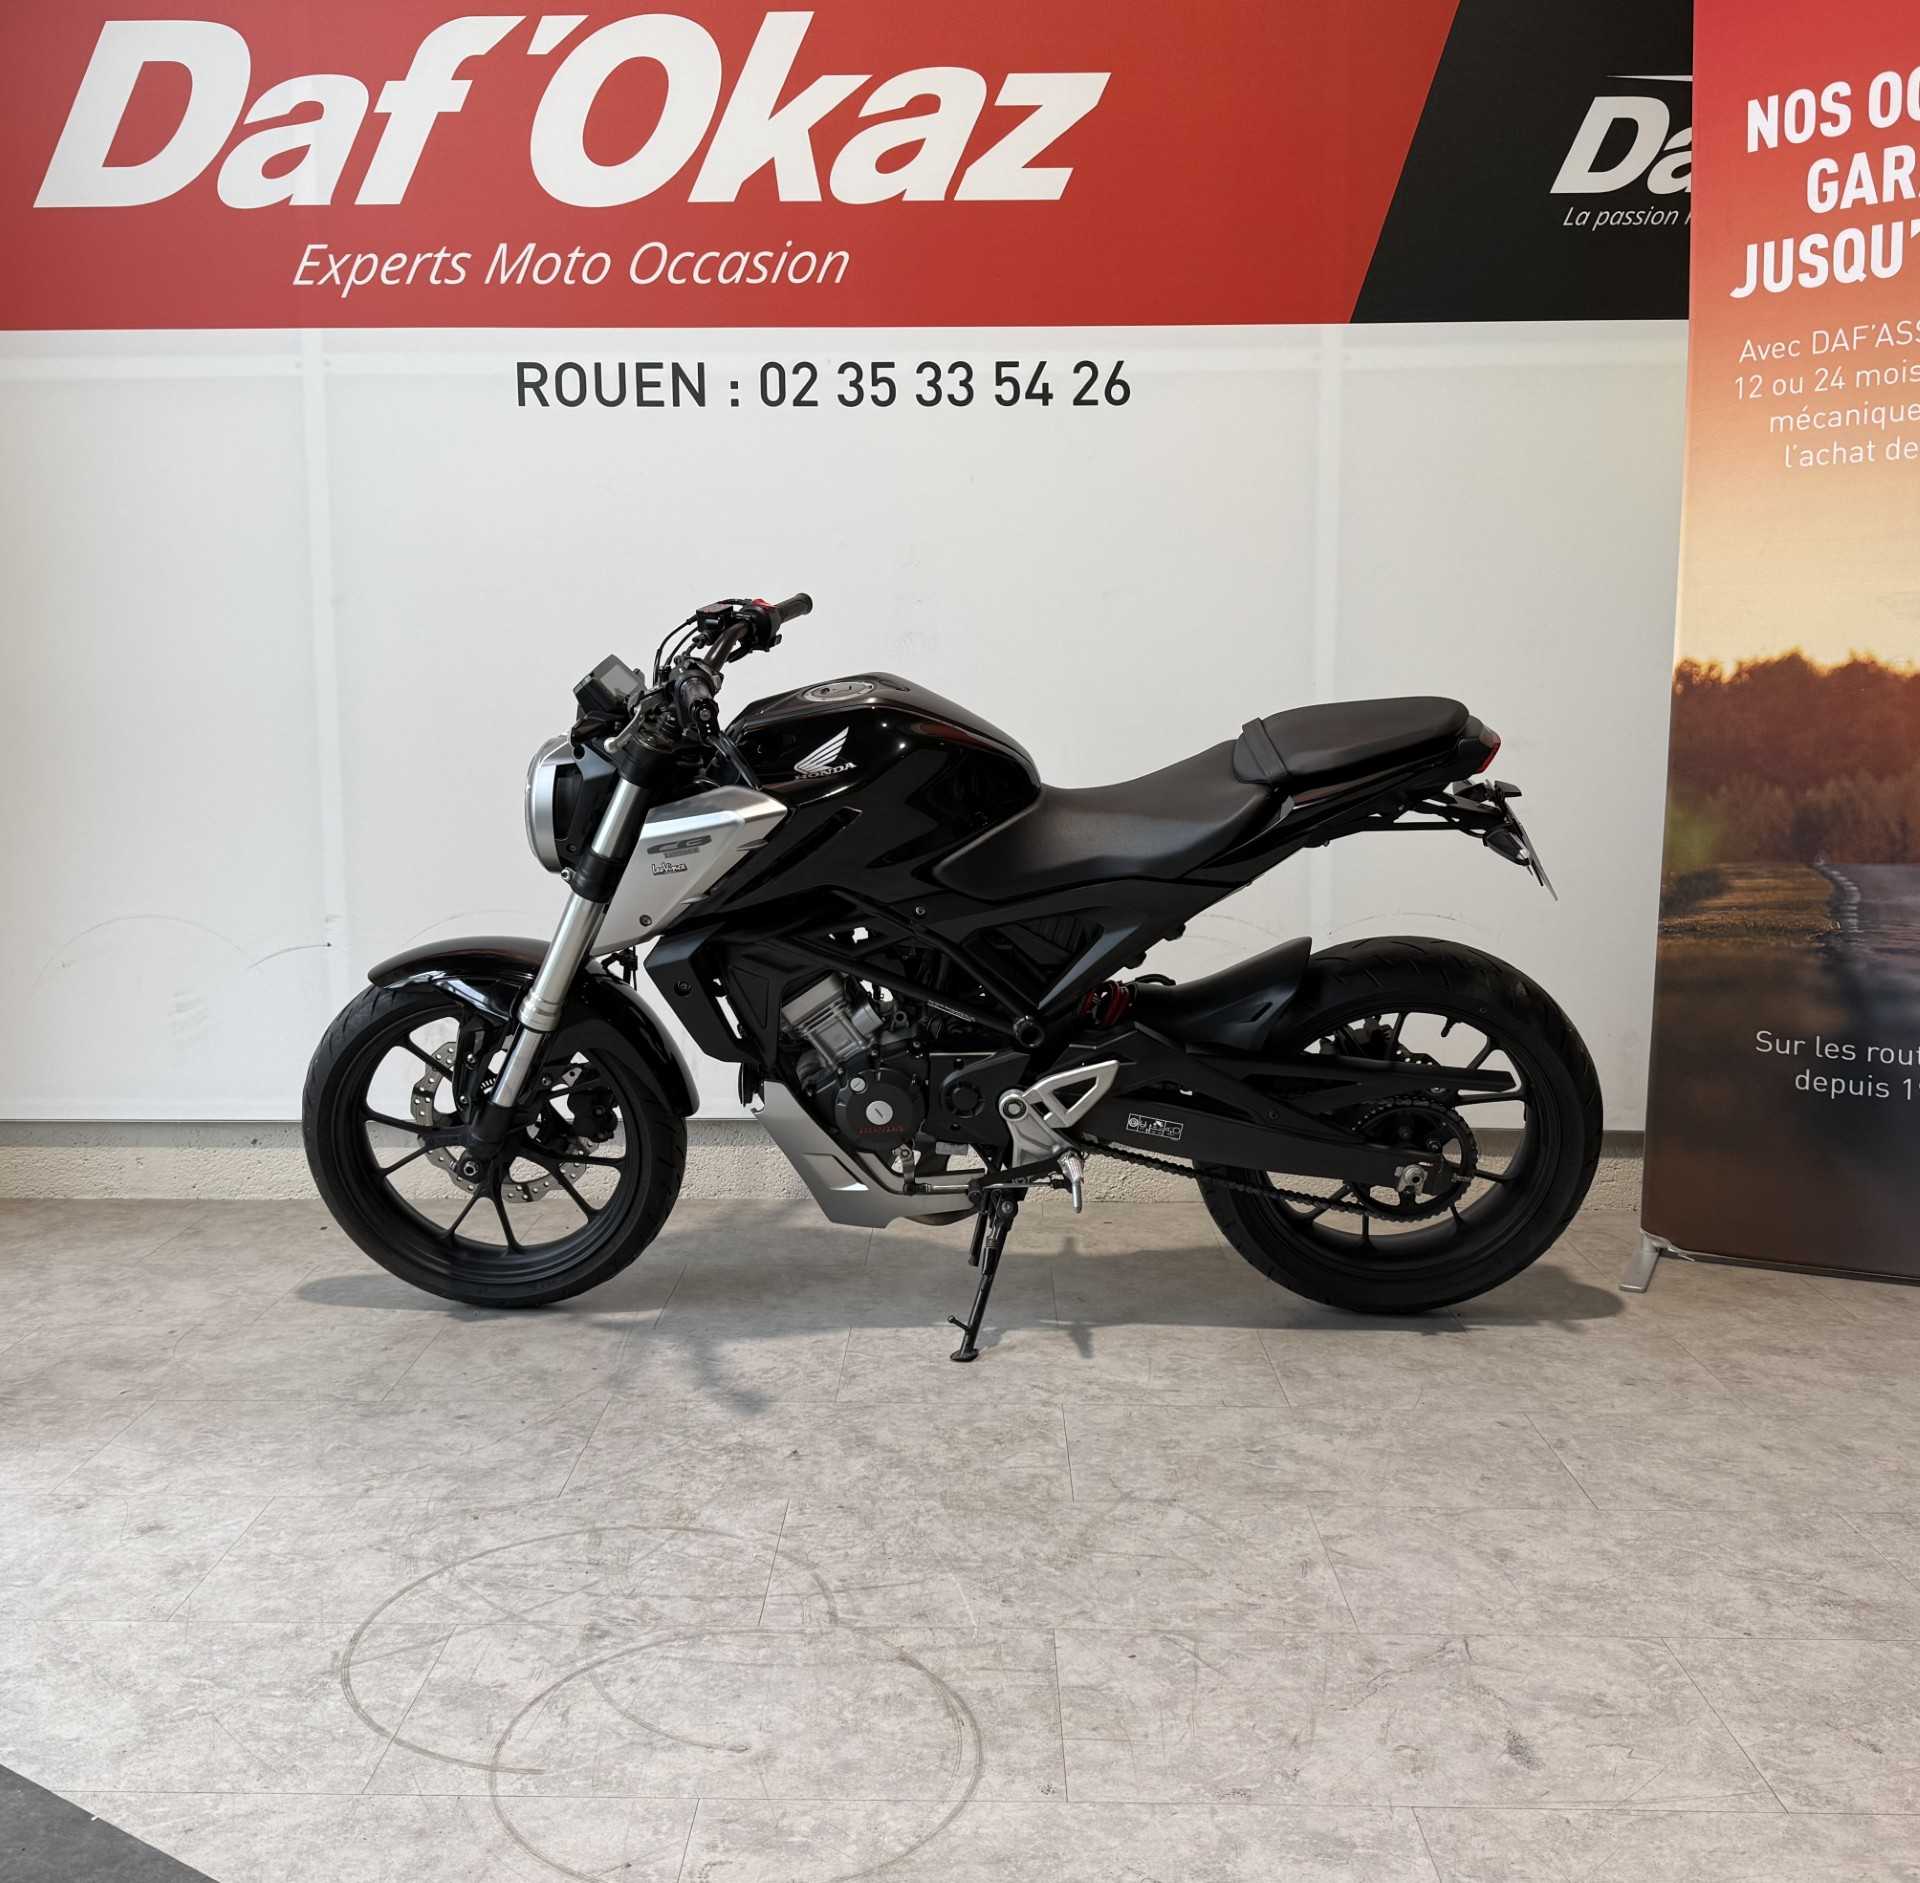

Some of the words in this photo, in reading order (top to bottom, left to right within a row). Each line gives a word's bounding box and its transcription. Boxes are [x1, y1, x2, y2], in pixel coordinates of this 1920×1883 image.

[33, 11, 1111, 210] Daf'Okaz
[1747, 81, 1851, 153] NOS
[1807, 144, 1920, 213] GAR
[1563, 206, 1591, 226] La
[1592, 205, 1679, 231] passion
[293, 243, 472, 298] Experts
[485, 243, 611, 285] Moto
[630, 241, 850, 285] Occasion
[1738, 338, 1801, 363] Avec
[517, 361, 706, 407] ROUEN
[730, 380, 740, 407] :
[760, 361, 819, 407] 02
[837, 361, 897, 407] 35
[915, 360, 974, 407] 33
[994, 360, 1054, 407] 54
[1072, 360, 1131, 407] 26
[1735, 374, 1763, 400] 12
[1772, 377, 1803, 396] ou
[1814, 366, 1846, 392] 24
[1855, 359, 1920, 388] mois
[1770, 401, 1920, 433] mécanique
[1785, 440, 1875, 468] l'achat
[1885, 435, 1919, 461] de
[794, 762, 857, 779] HONDA
[1755, 1030, 1806, 1056] Sur
[1815, 1035, 1856, 1061] les
[1795, 1068, 1890, 1100] depuis
[1903, 1078, 1920, 1100] 1
